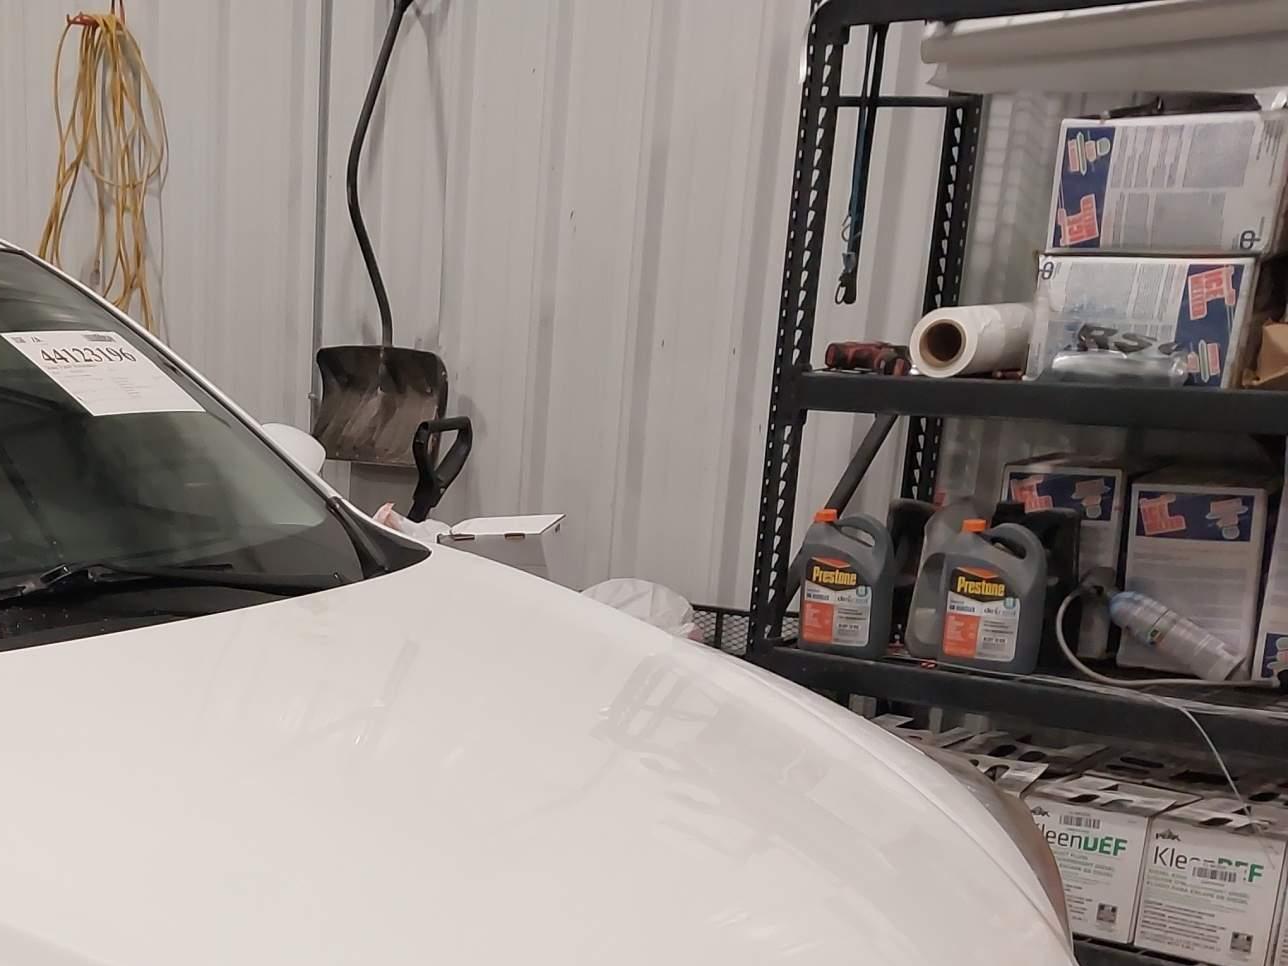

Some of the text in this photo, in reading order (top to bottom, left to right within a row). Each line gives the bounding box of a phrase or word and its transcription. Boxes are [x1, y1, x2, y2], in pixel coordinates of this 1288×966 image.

[40, 347, 137, 364] 44123196
[812, 566, 857, 586] Prestone
[956, 576, 1006, 597] Prestone
[1037, 823, 1128, 857] leenDEF
